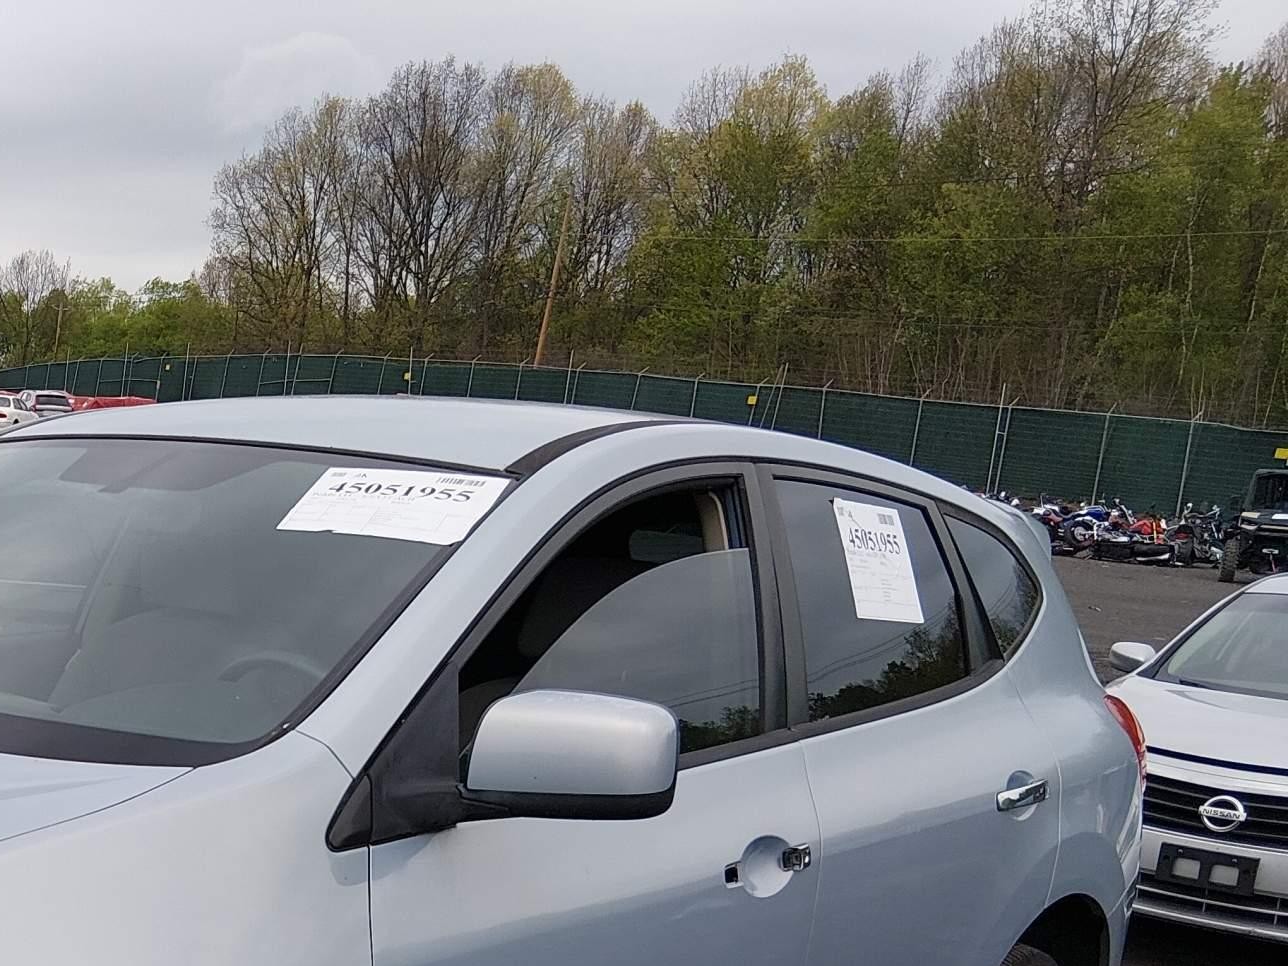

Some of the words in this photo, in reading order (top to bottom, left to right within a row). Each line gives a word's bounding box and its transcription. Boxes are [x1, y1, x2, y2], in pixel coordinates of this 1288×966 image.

[328, 481, 476, 503] 45051955
[849, 527, 901, 555] 45051955
[1202, 807, 1241, 820] NISSAN
